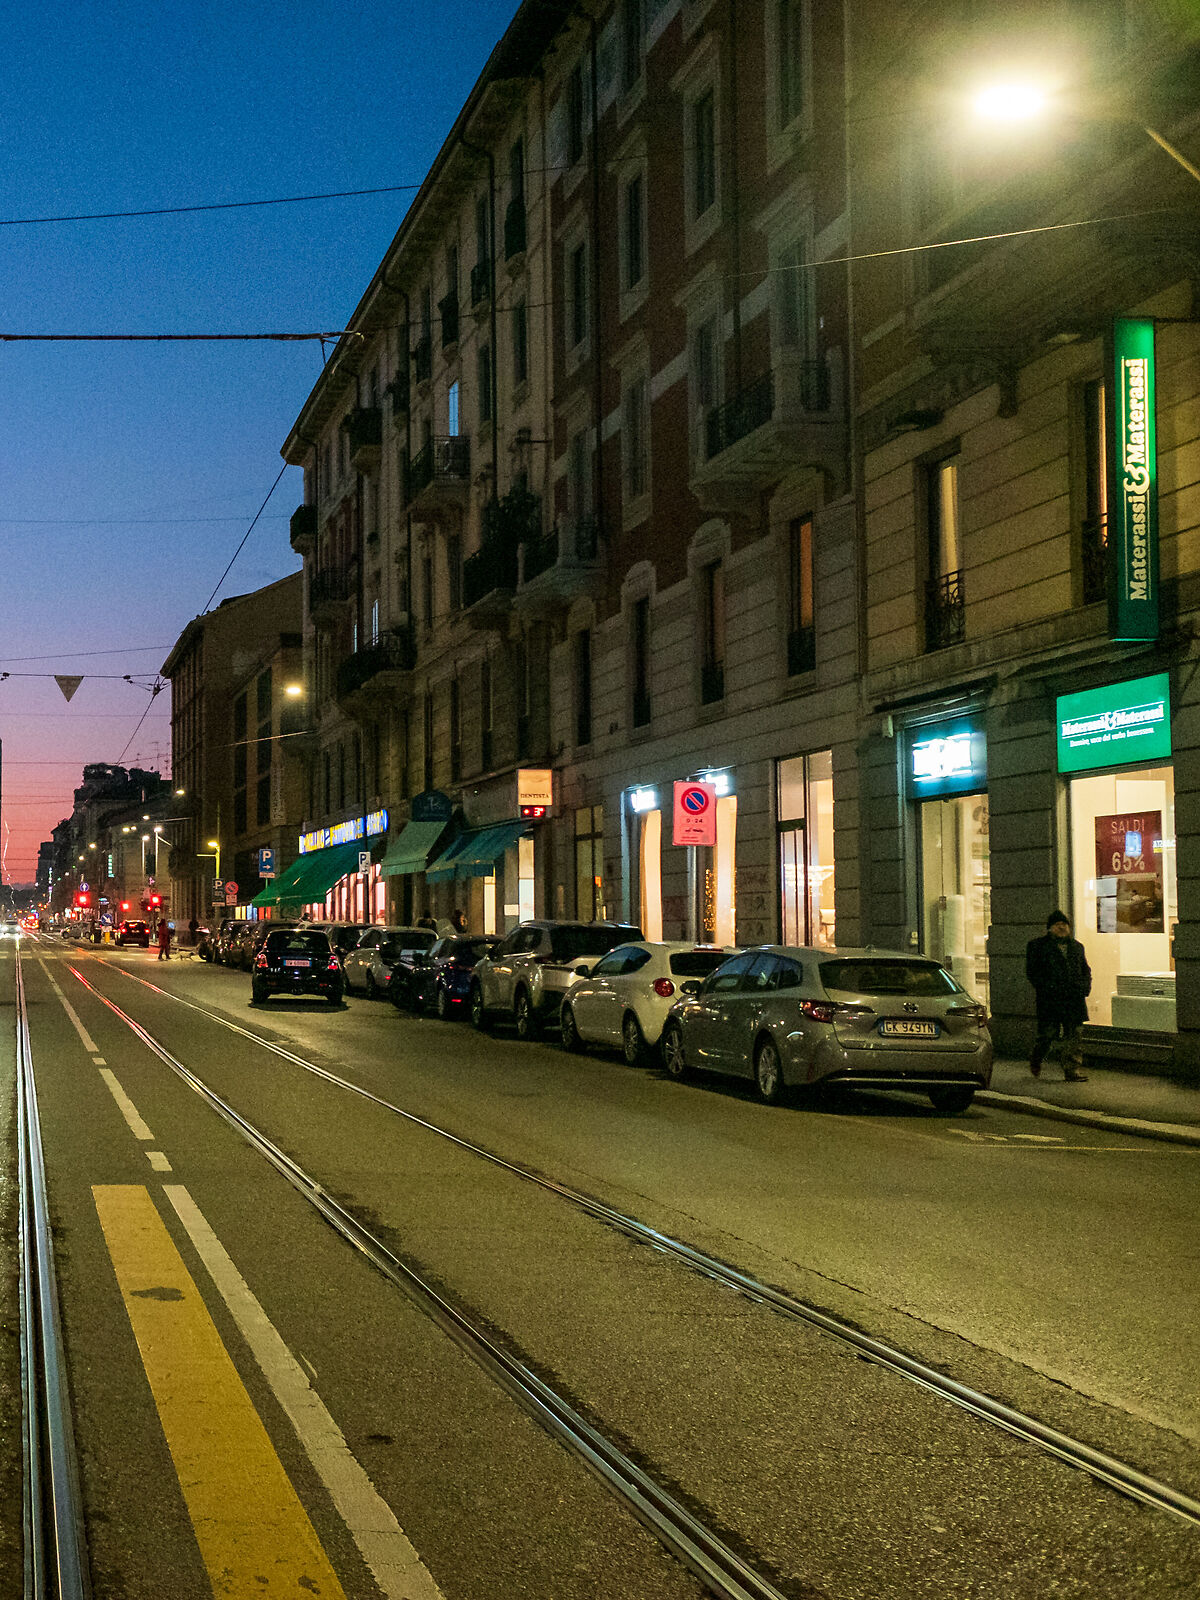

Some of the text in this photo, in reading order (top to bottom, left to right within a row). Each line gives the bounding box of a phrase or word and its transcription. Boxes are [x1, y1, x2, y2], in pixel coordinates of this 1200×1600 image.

[1125, 358, 1146, 465] Materassi
[1129, 493, 1148, 600] Materassi
[1111, 819, 1145, 834] SALDI
[262, 850, 272, 862] P
[360, 853, 367, 864] P
[215, 880, 223, 889] P
